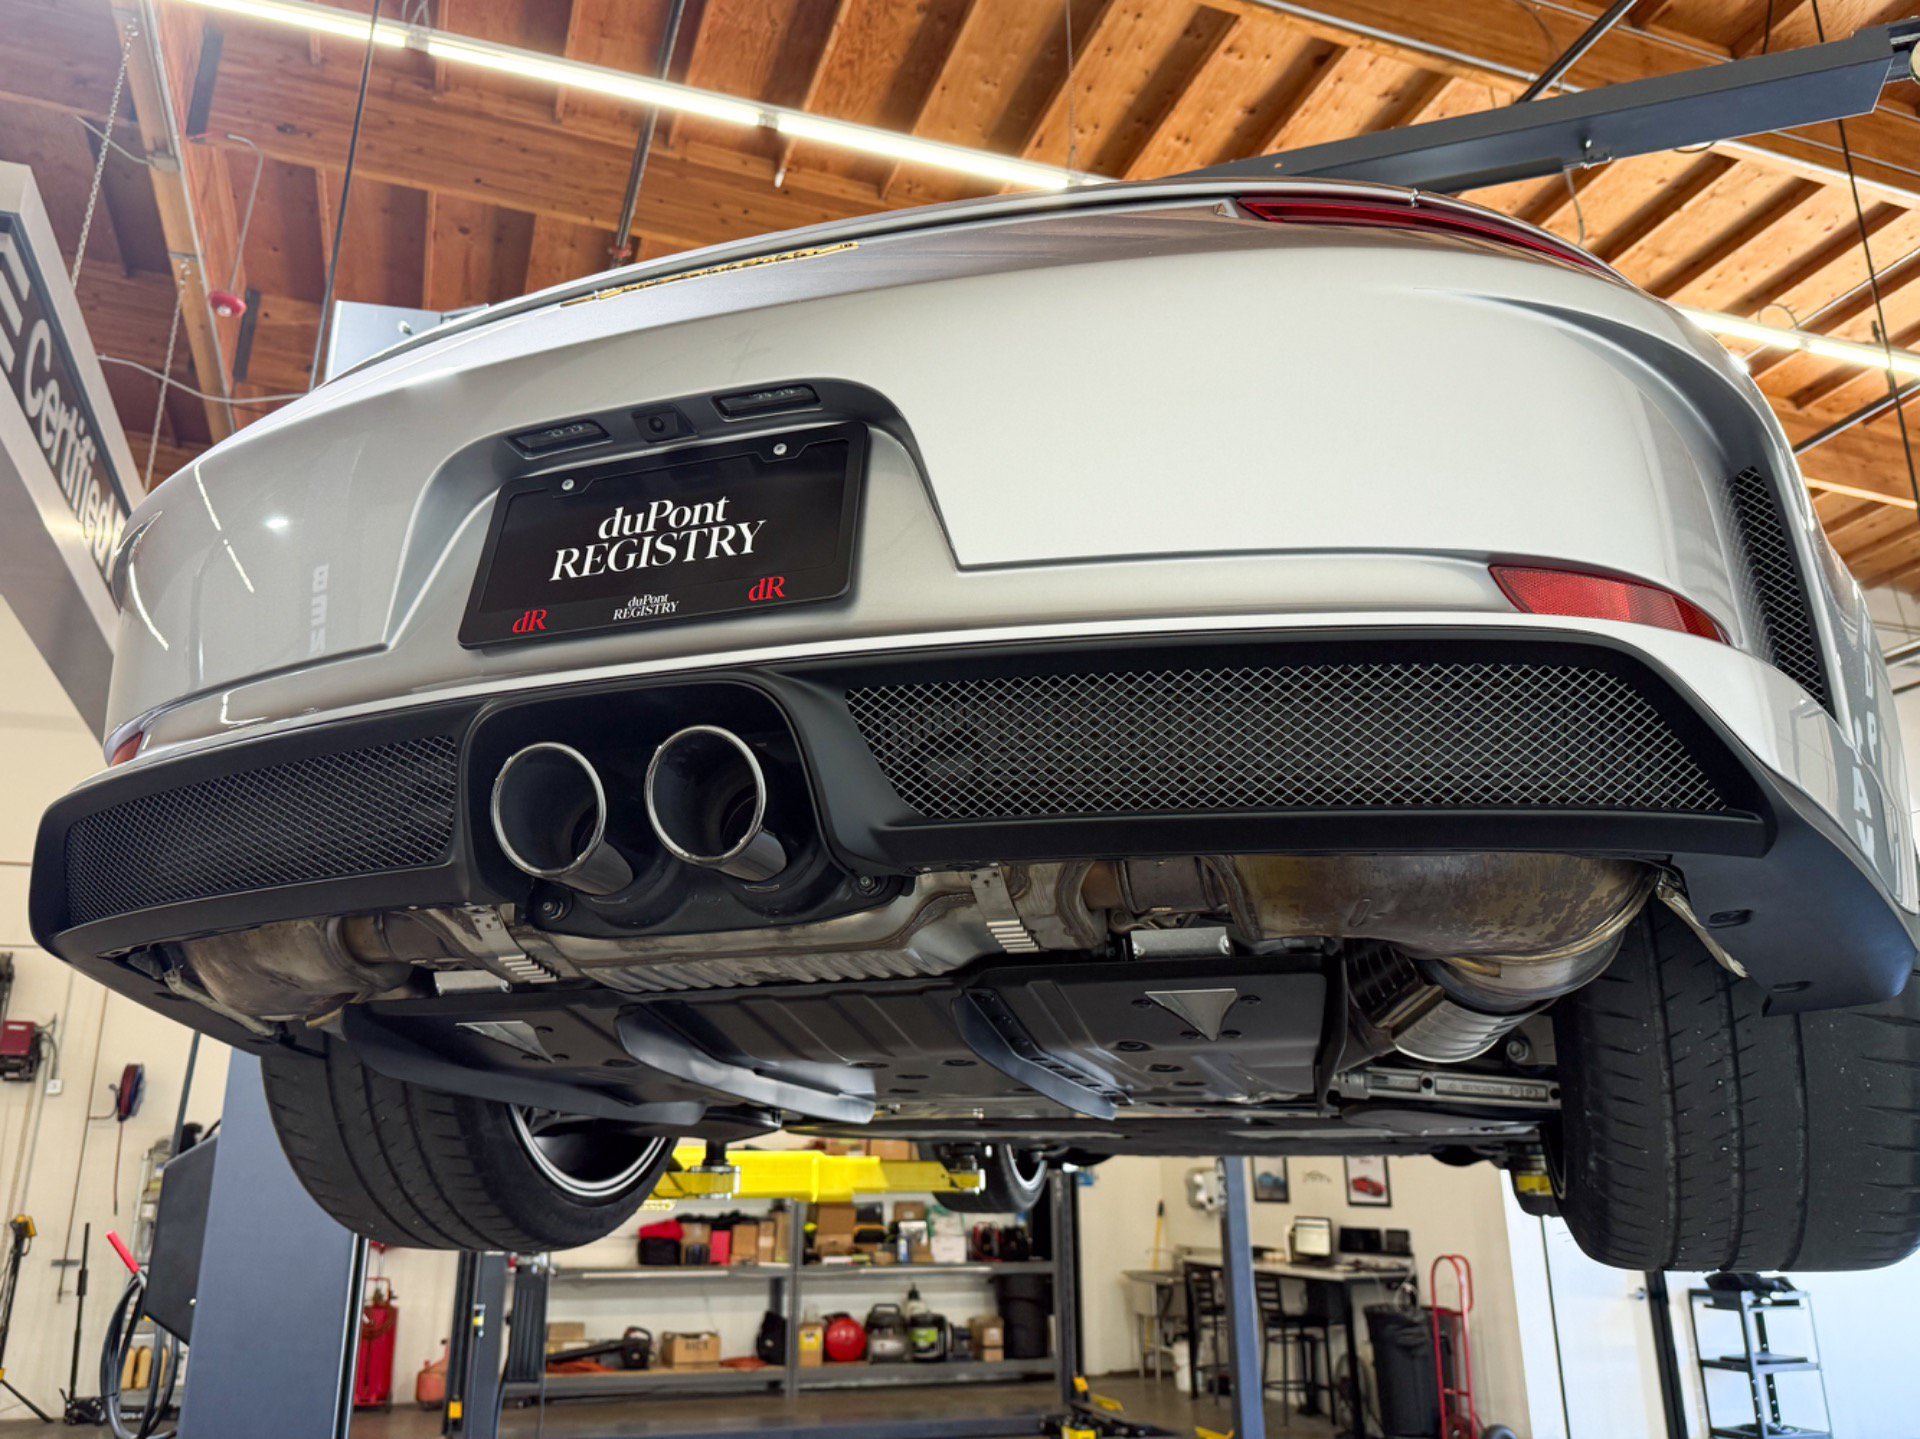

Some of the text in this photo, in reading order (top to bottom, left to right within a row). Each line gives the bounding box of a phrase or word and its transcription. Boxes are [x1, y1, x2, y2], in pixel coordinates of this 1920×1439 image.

[24, 318, 115, 569] Certified
[598, 496, 730, 540] duPont
[548, 519, 767, 582] REGISTRY
[627, 593, 669, 608] duPont
[748, 576, 785, 603] dR
[512, 609, 548, 634] dR
[613, 600, 678, 621] REGISTRY
